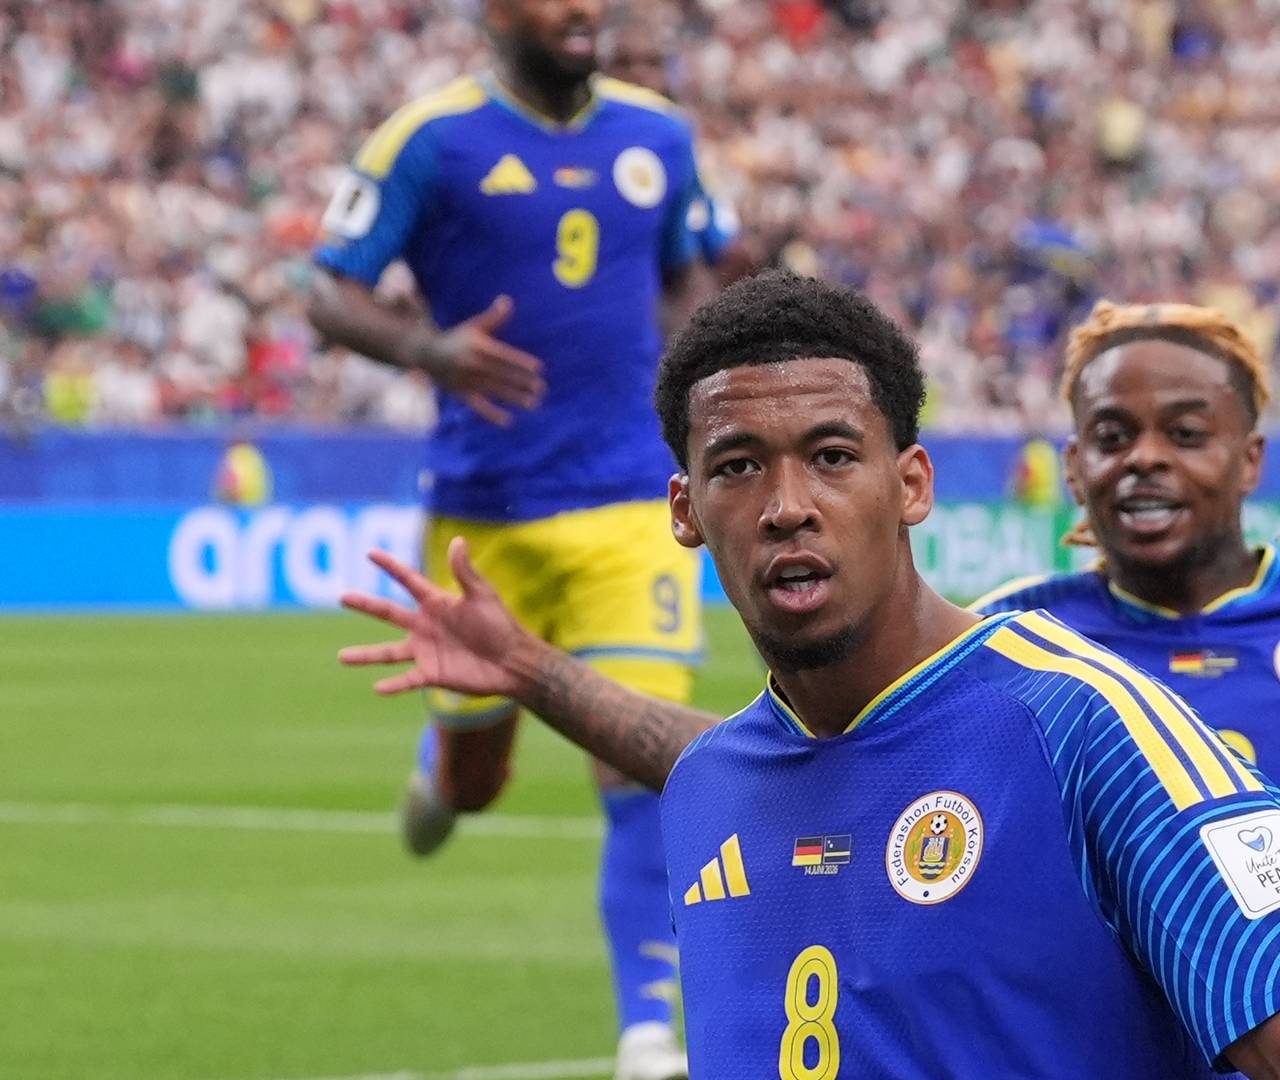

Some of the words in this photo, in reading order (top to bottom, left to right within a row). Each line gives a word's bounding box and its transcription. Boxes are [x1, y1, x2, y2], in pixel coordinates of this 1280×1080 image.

[553, 208, 600, 288] 9
[652, 572, 680, 634] 9
[891, 802, 930, 886] Federashon
